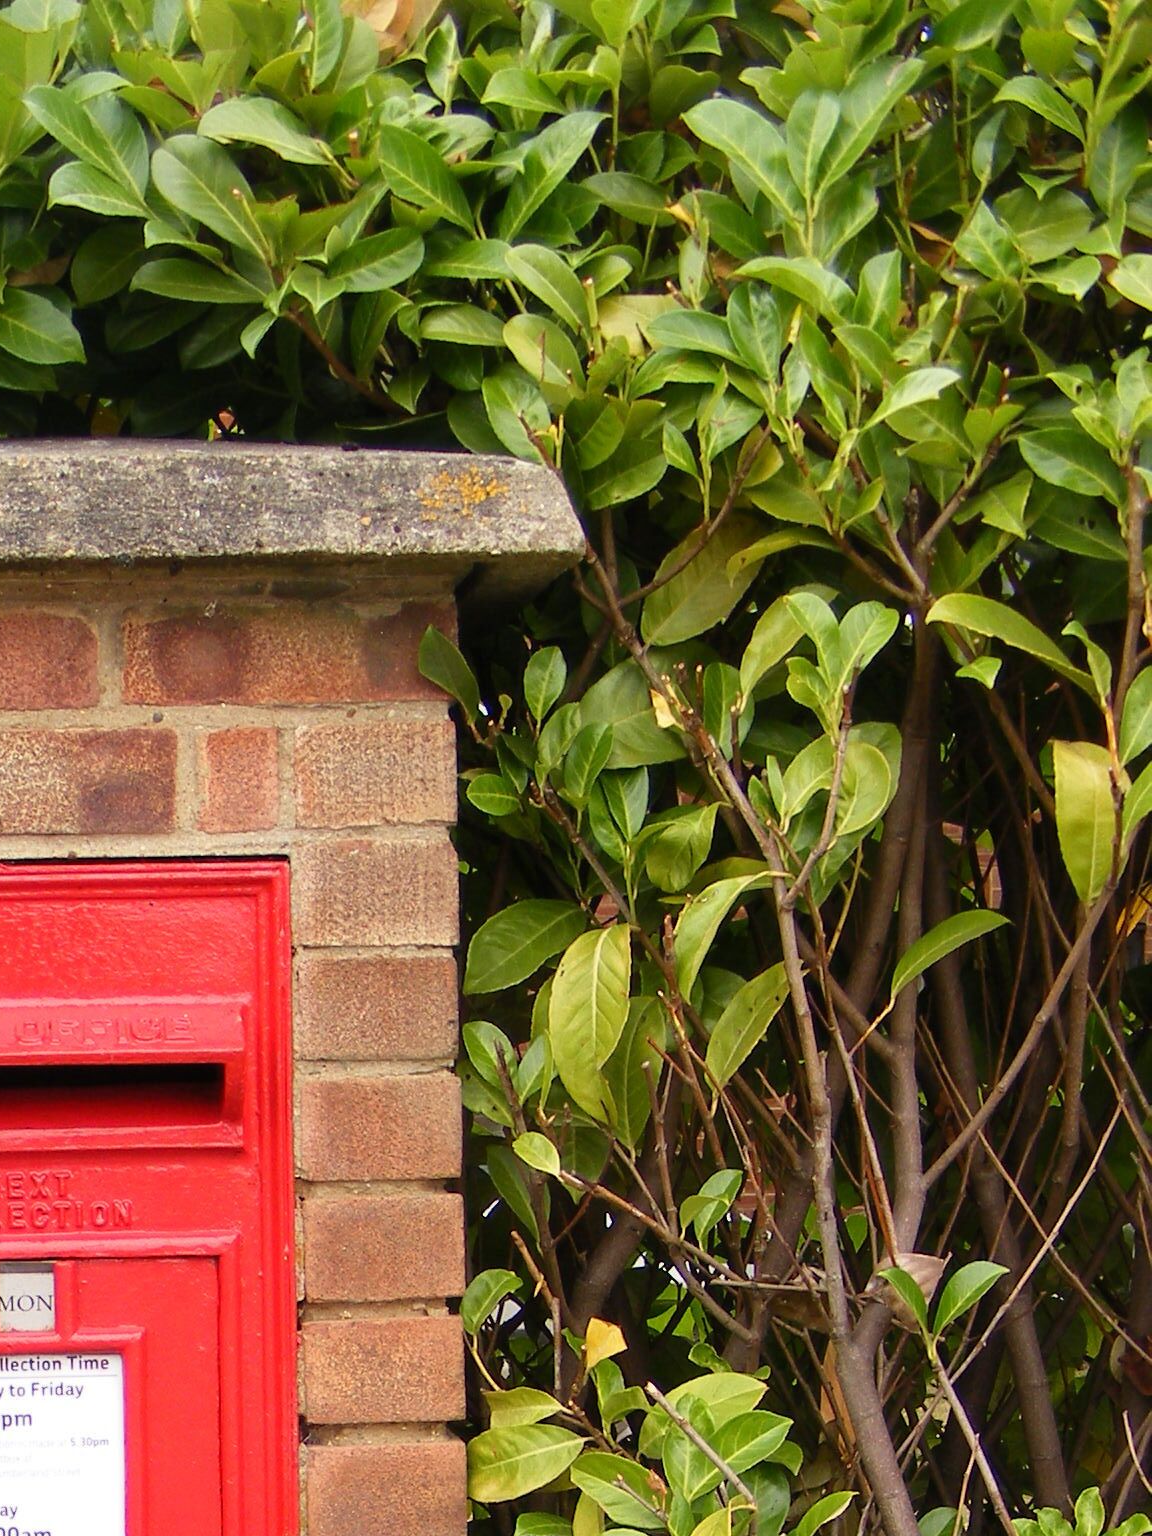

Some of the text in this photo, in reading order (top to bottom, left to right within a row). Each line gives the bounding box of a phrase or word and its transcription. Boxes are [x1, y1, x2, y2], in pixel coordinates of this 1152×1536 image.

[15, 1014, 196, 1046] OFFICE
[67, 1355, 110, 1371] Time
[9, 1384, 26, 1397] to
[31, 1382, 84, 1399] Friday
